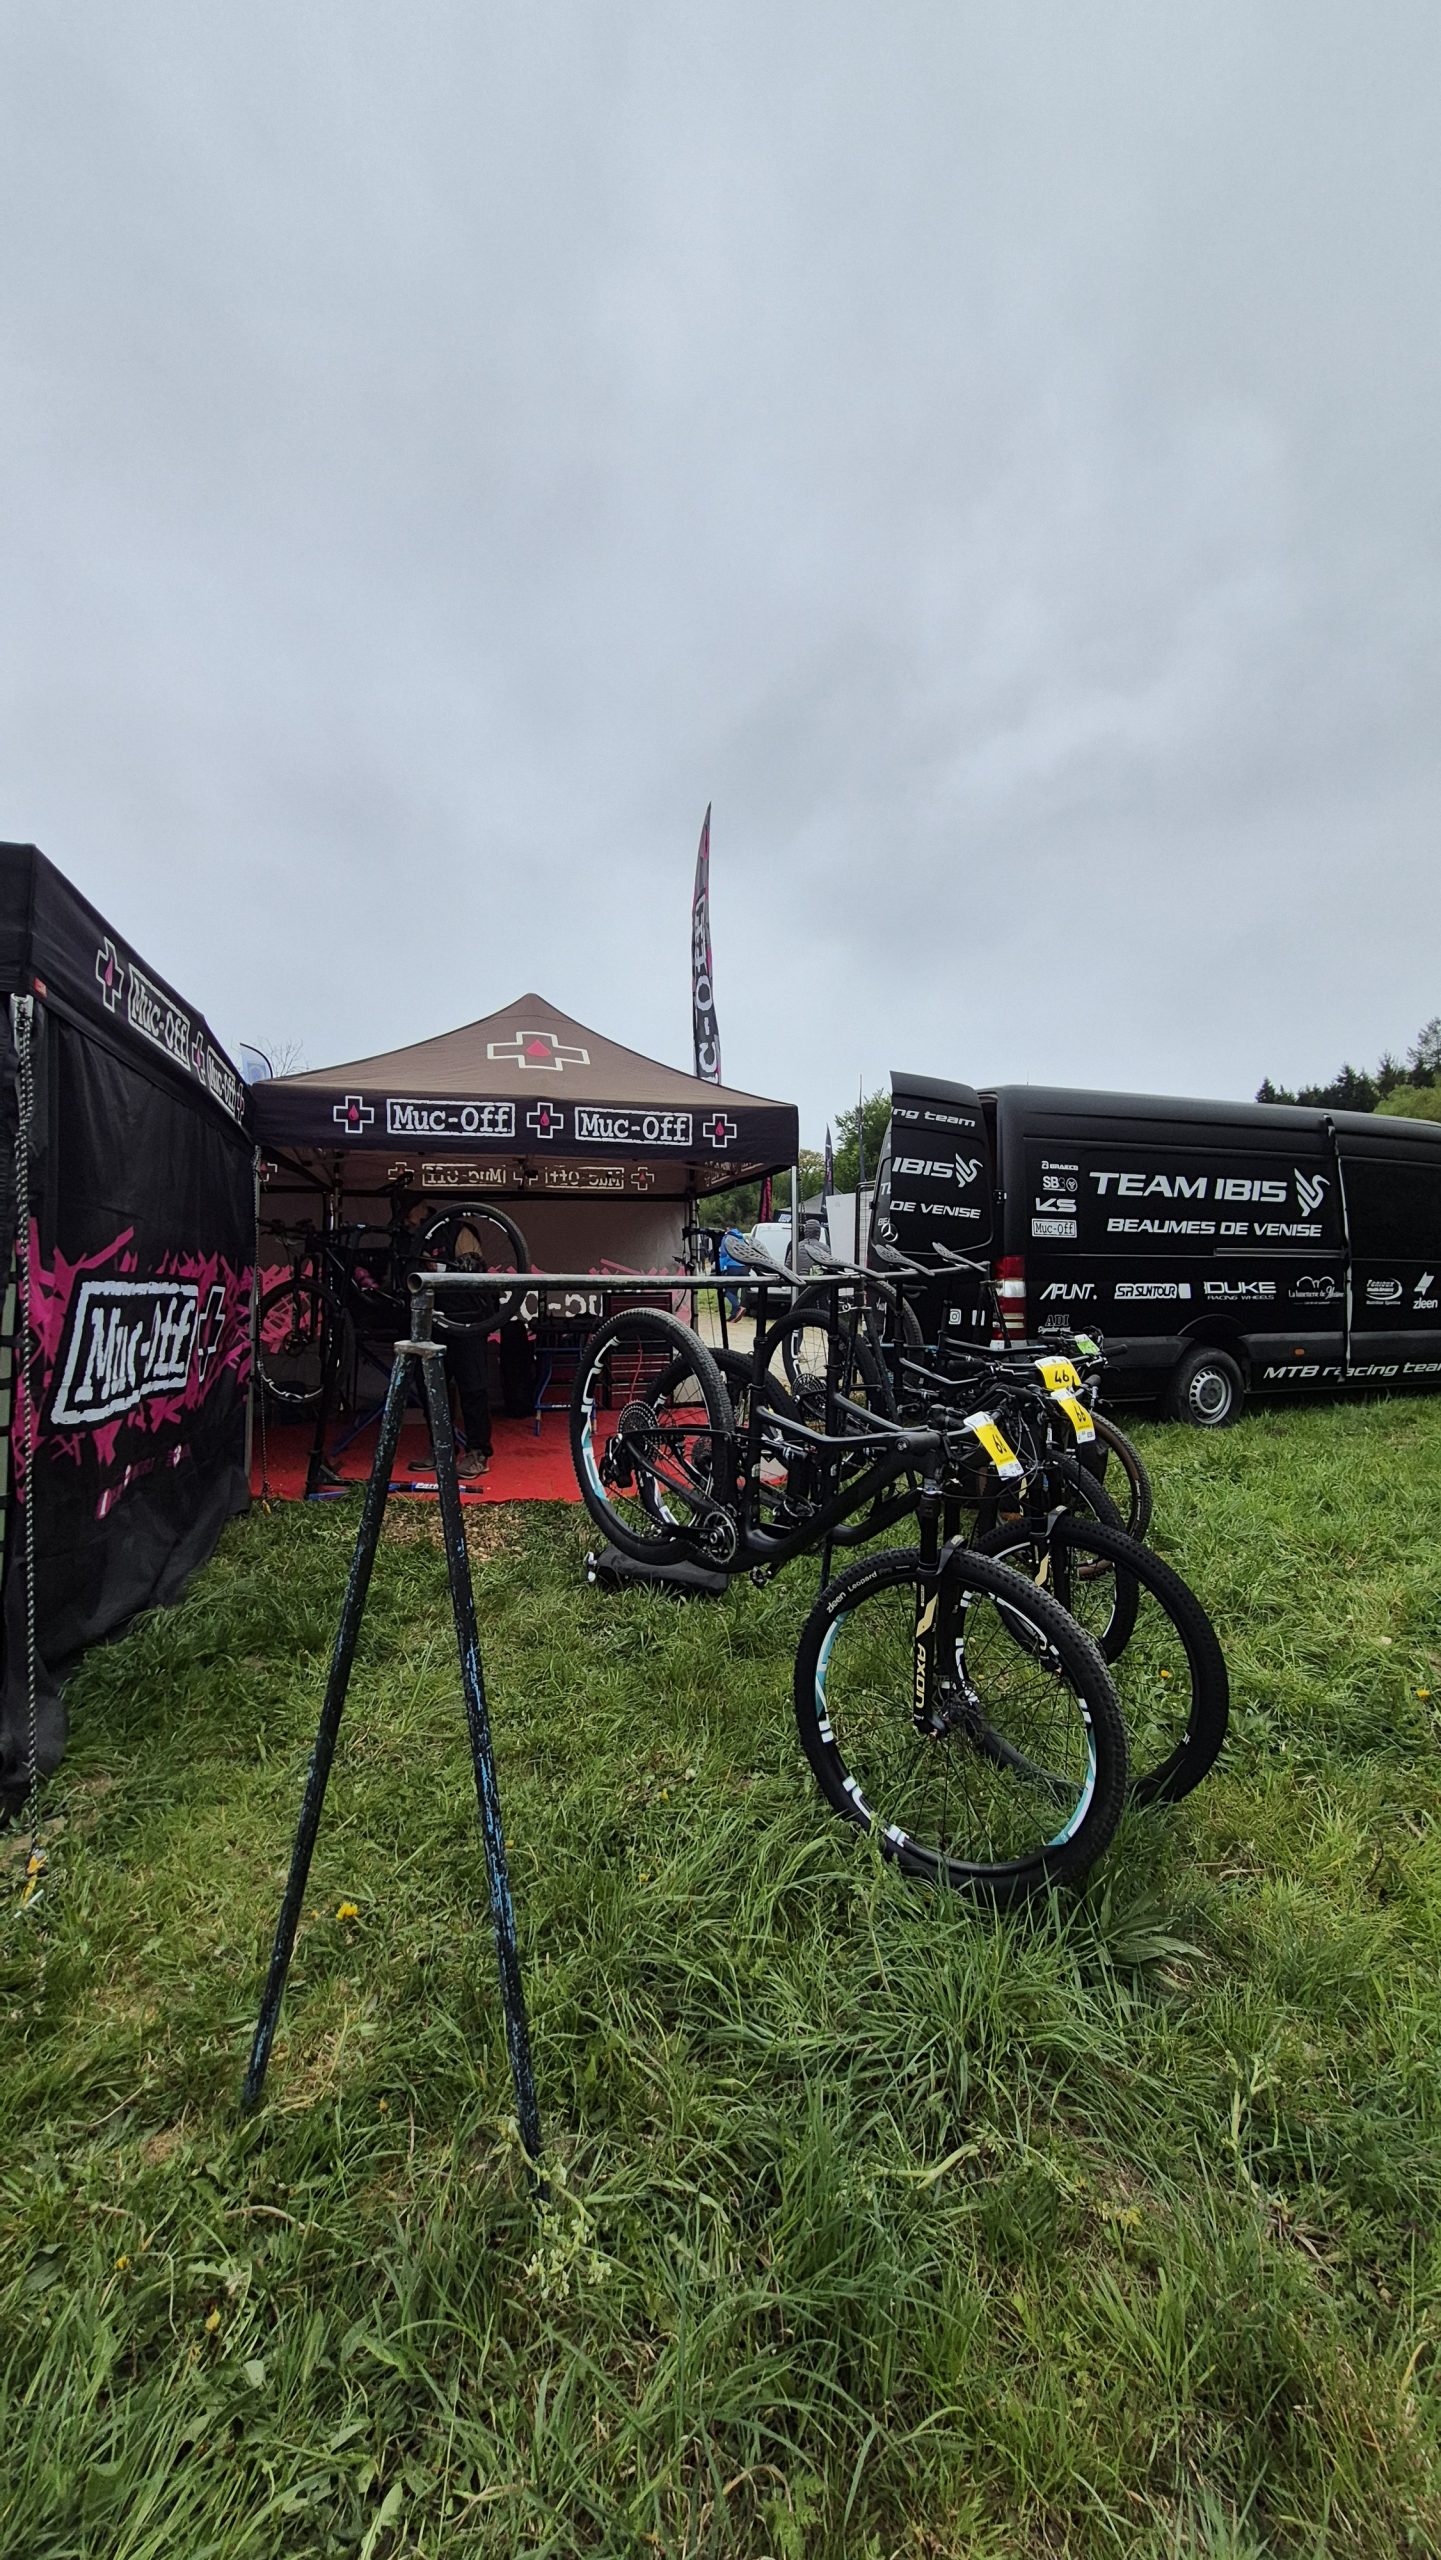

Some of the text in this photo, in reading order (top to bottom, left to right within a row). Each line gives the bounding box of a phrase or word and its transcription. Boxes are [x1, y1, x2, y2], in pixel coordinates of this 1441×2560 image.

[131, 976, 188, 1060] Muc-Off
[393, 1105, 511, 1132] Muc-Off
[581, 1113, 687, 1141] Muc-Off
[924, 1111, 976, 1127] team
[892, 1157, 954, 1178] IBIS
[1089, 1172, 1288, 1203] TEAM IBIS
[889, 1200, 981, 1219] DE VENISE
[1035, 1222, 1074, 1236] Muc-Off
[1107, 1218, 1323, 1237] BEAUMES DE VENISE
[1203, 1281, 1277, 1294] DUKE
[1413, 1297, 1438, 1310] zleen
[1055, 1369, 1069, 1383] 46
[1263, 1366, 1320, 1379] MTB
[826, 1570, 878, 1614] zleen Leopard
